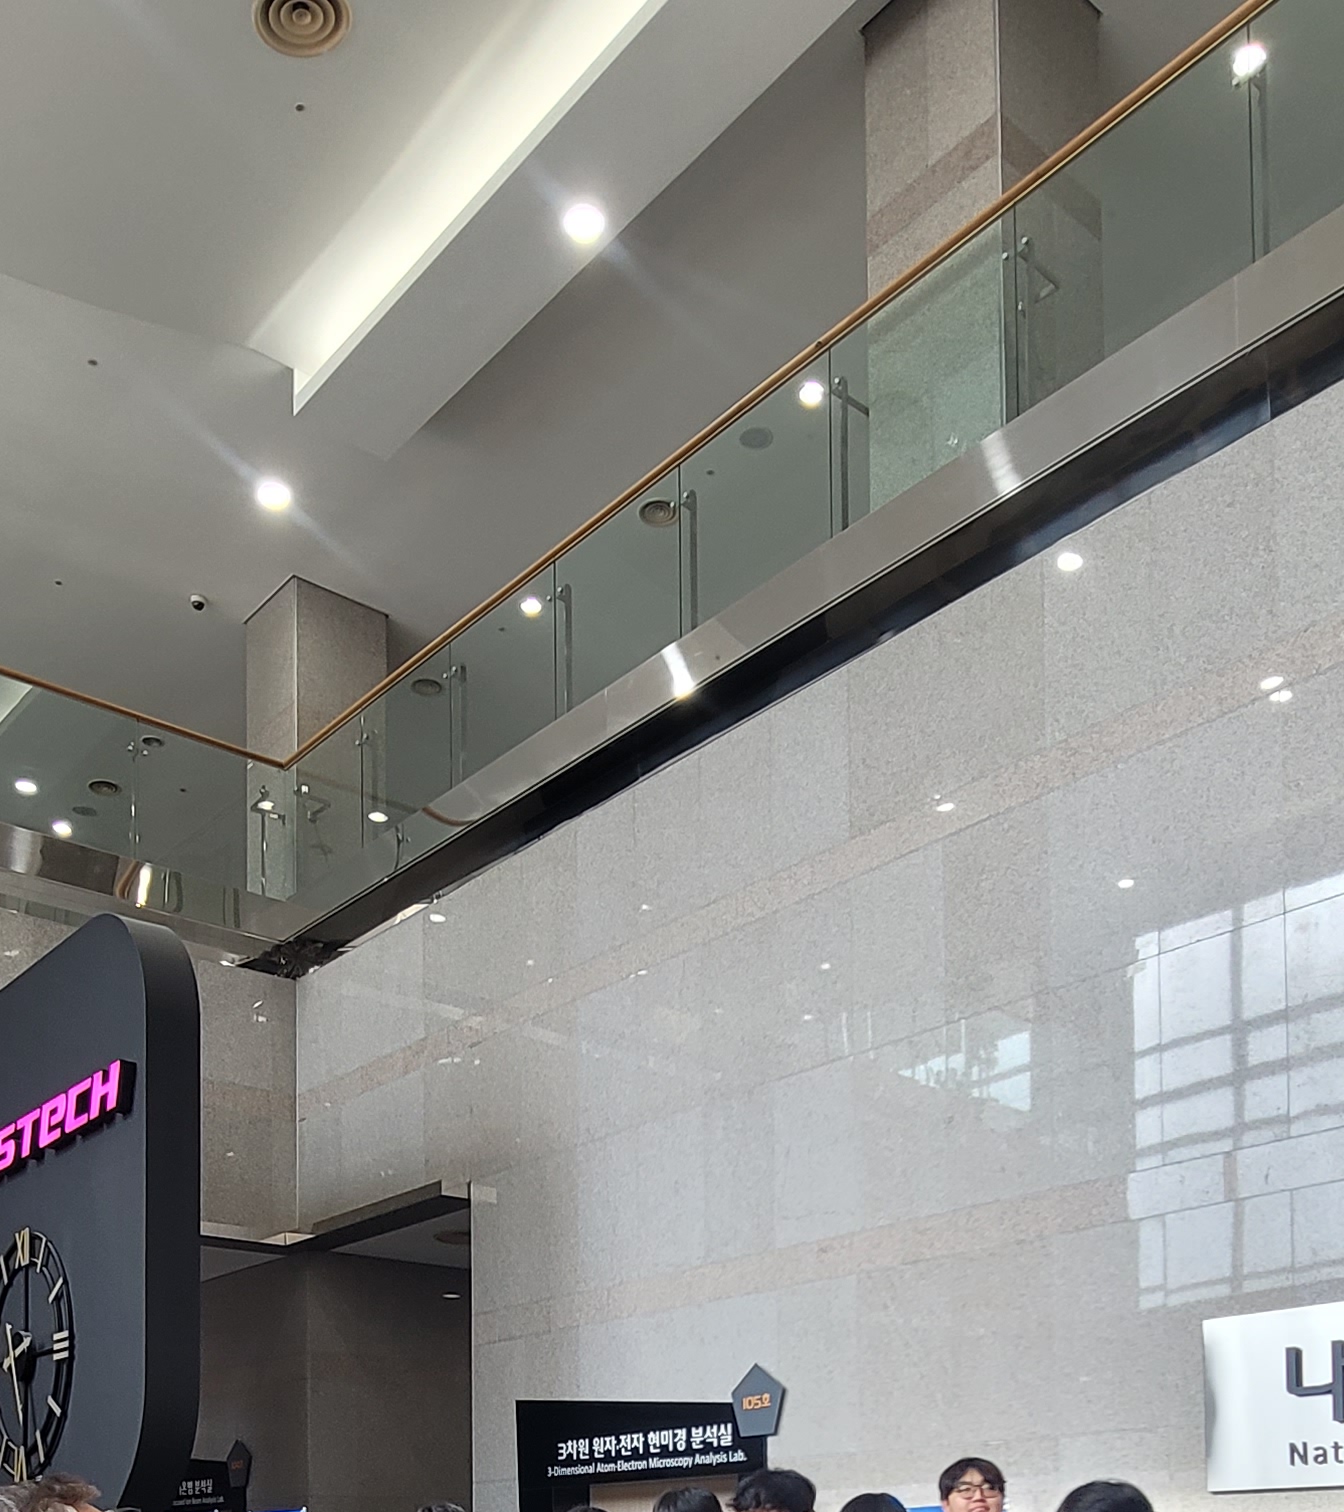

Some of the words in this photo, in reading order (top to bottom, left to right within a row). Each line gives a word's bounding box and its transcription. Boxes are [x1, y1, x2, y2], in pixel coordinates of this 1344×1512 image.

[742, 1393, 771, 1410] 105호
[557, 1438, 590, 1460] 3차원
[647, 1428, 687, 1453] 현미경
[690, 1423, 733, 1449] 분석실
[547, 1462, 595, 1477] 3-Dimensional
[596, 1459, 647, 1473] Atom-Electron
[649, 1455, 692, 1469] Microscopy
[694, 1451, 727, 1466] Analysis
[729, 1449, 748, 1462] Lab.
